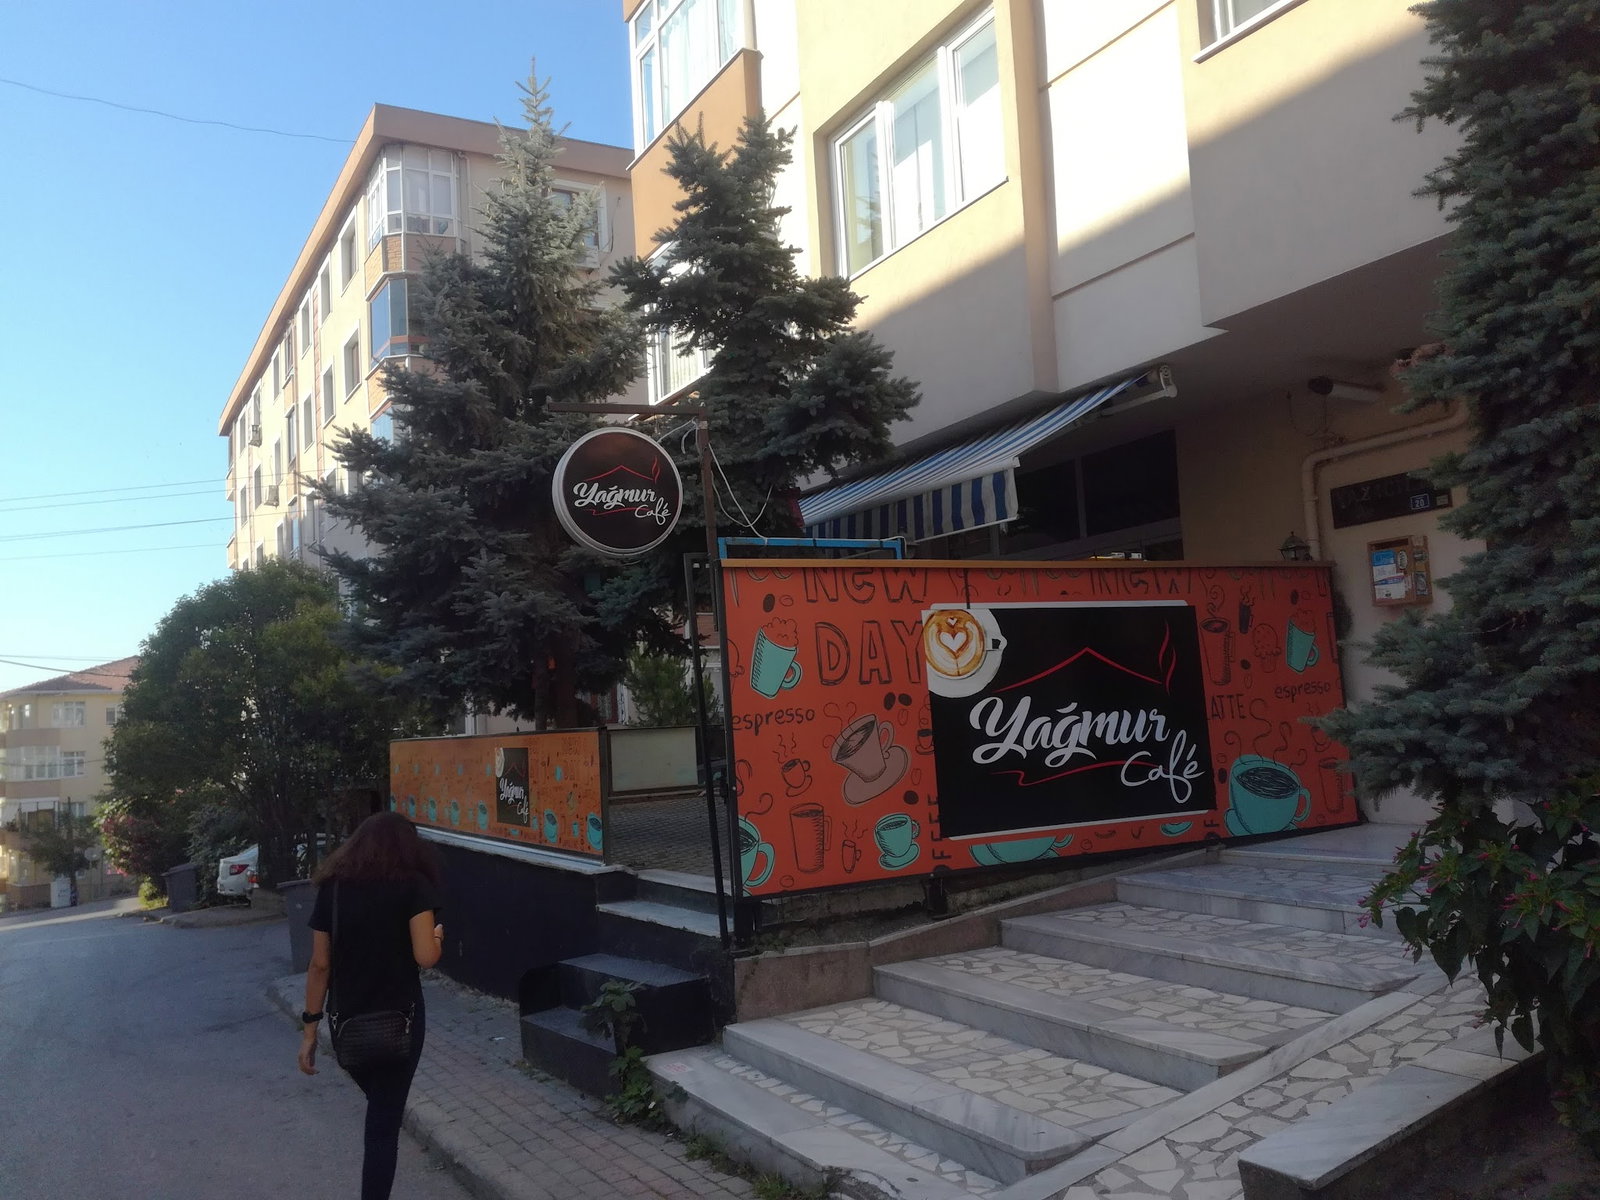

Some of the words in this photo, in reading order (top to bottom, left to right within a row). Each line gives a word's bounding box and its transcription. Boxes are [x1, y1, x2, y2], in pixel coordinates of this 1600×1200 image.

[573, 482, 657, 510] Yağmur
[1415, 499, 1424, 508] 20
[634, 497, 672, 525] Café
[815, 620, 924, 686] DAY
[1207, 693, 1247, 720] ATTE
[1274, 682, 1331, 703] espresso
[731, 707, 815, 737] espresso
[969, 695, 1170, 769] Yağmur
[1120, 729, 1205, 805] Café
